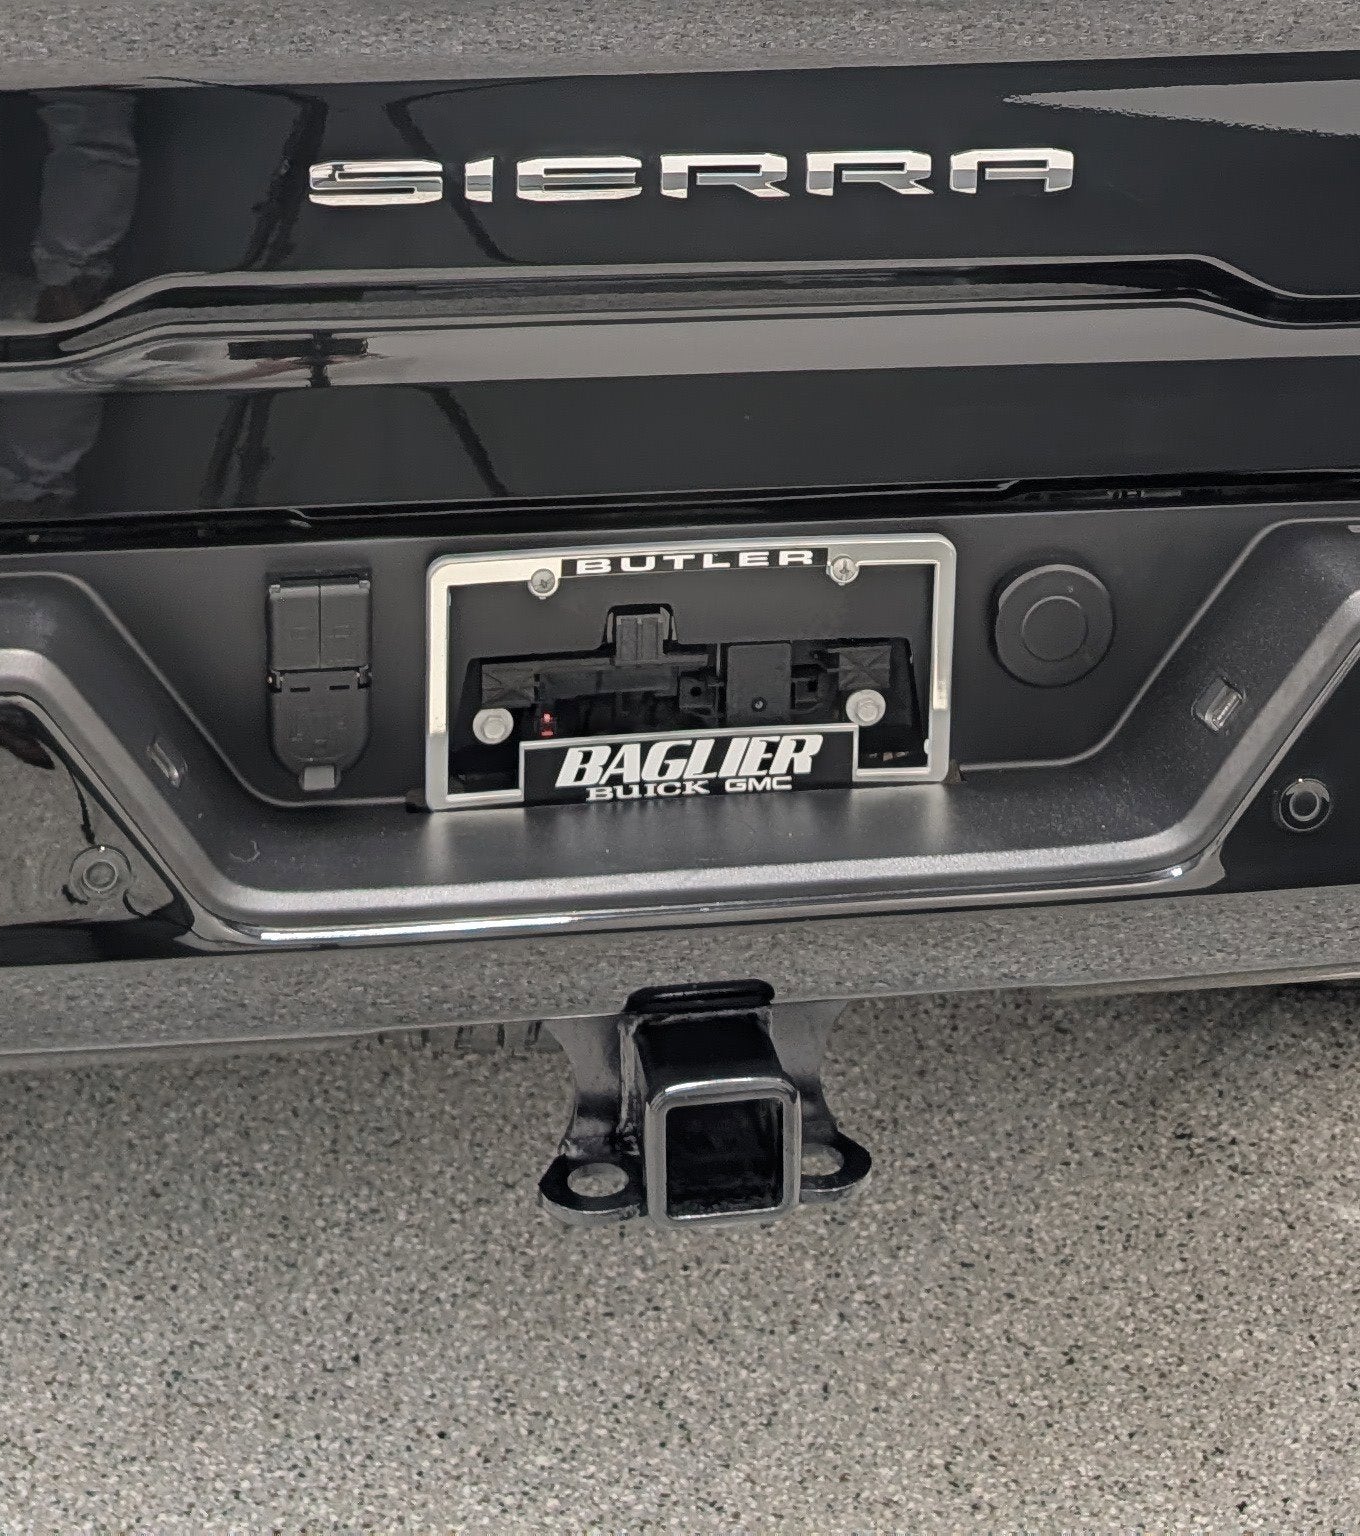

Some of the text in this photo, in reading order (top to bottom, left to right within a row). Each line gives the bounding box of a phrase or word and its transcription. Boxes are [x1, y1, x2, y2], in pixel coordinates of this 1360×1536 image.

[308, 147, 1075, 206] SIERRA
[576, 550, 814, 575] BUTLER
[555, 734, 824, 788] BAGLIER
[585, 776, 793, 802] BUICK GMC
